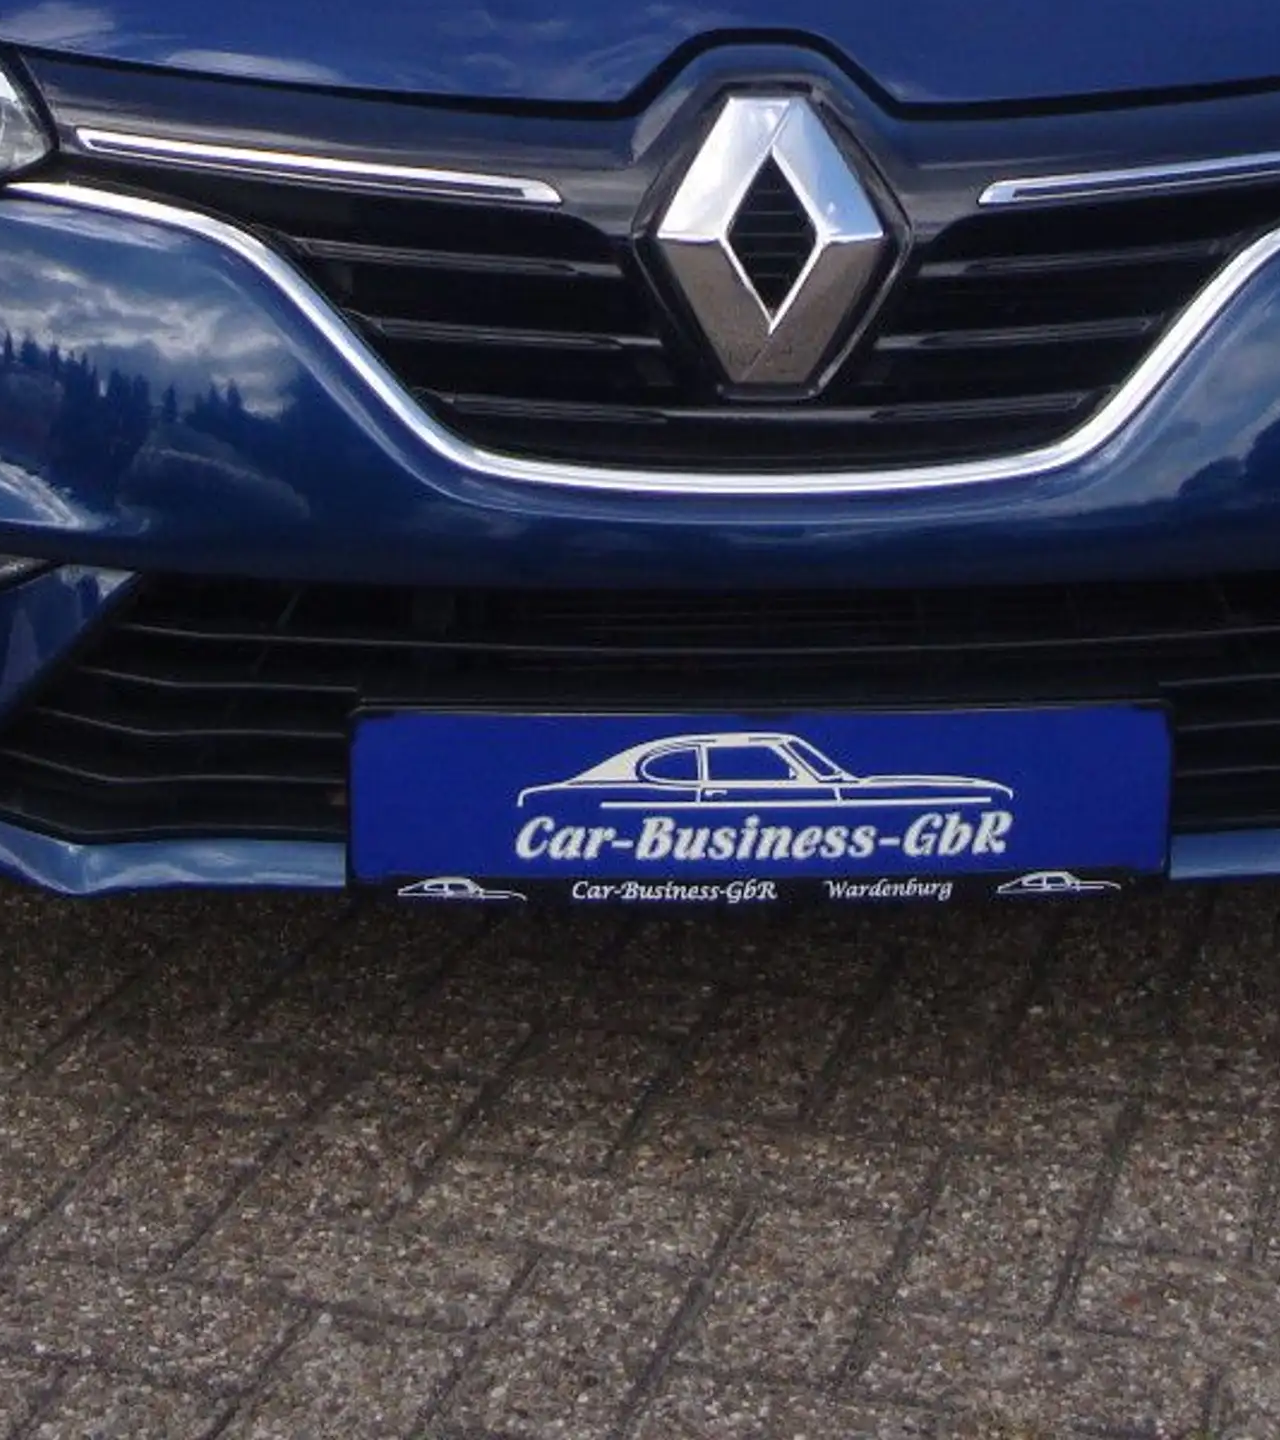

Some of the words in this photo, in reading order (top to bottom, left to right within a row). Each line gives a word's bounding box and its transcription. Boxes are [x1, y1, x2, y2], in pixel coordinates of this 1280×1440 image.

[516, 811, 1013, 860] Car-Business-GbR
[571, 879, 779, 904] Car-Business-GbR
[824, 877, 954, 902] Wardenburg
